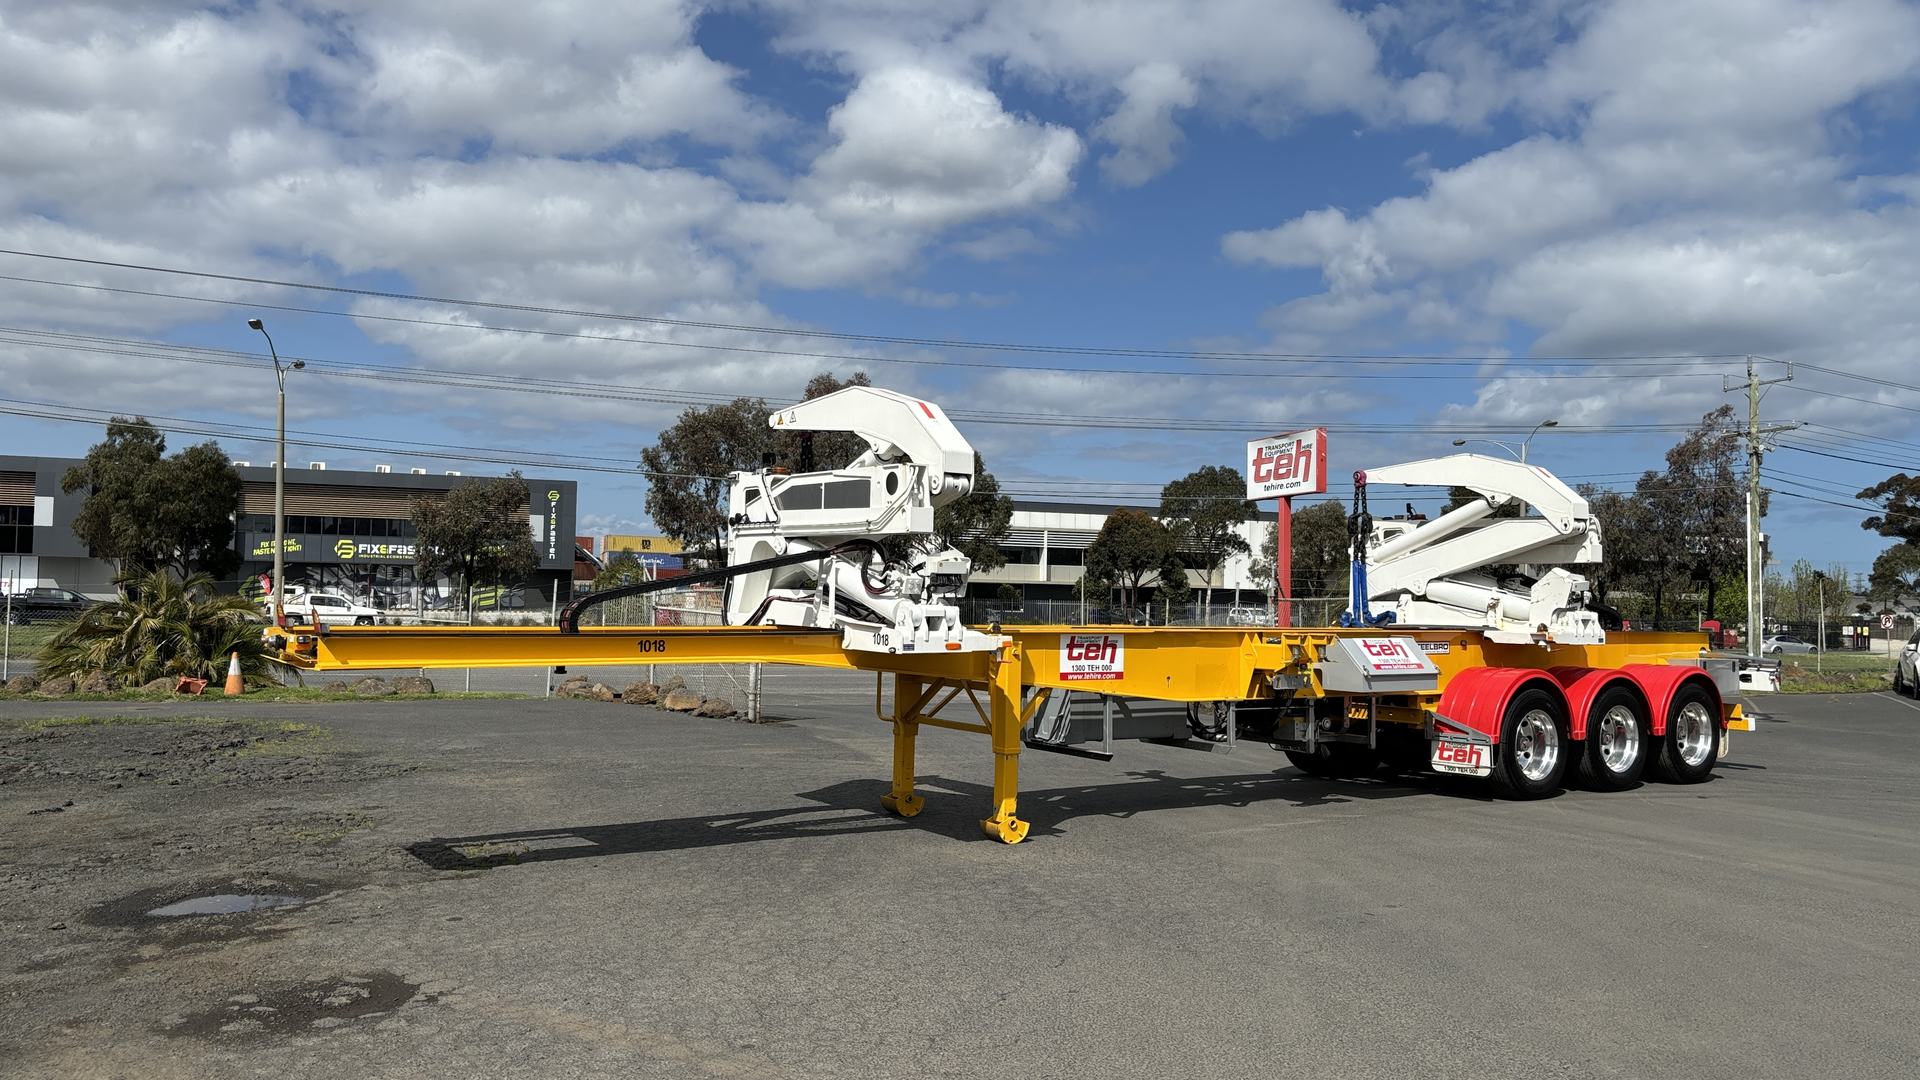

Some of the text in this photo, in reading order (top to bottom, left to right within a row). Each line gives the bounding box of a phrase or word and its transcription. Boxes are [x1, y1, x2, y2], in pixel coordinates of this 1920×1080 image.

[1265, 441, 1295, 451] TRANSPORT
[1265, 448, 1293, 457] EQUIPMENT
[1252, 439, 1312, 483] teh
[1264, 481, 1301, 492] tehire.com
[637, 639, 666, 653] 1018
[873, 632, 889, 646] 1018
[1066, 636, 1117, 664] teh
[1362, 639, 1408, 658] teh
[1438, 741, 1482, 768] teh
